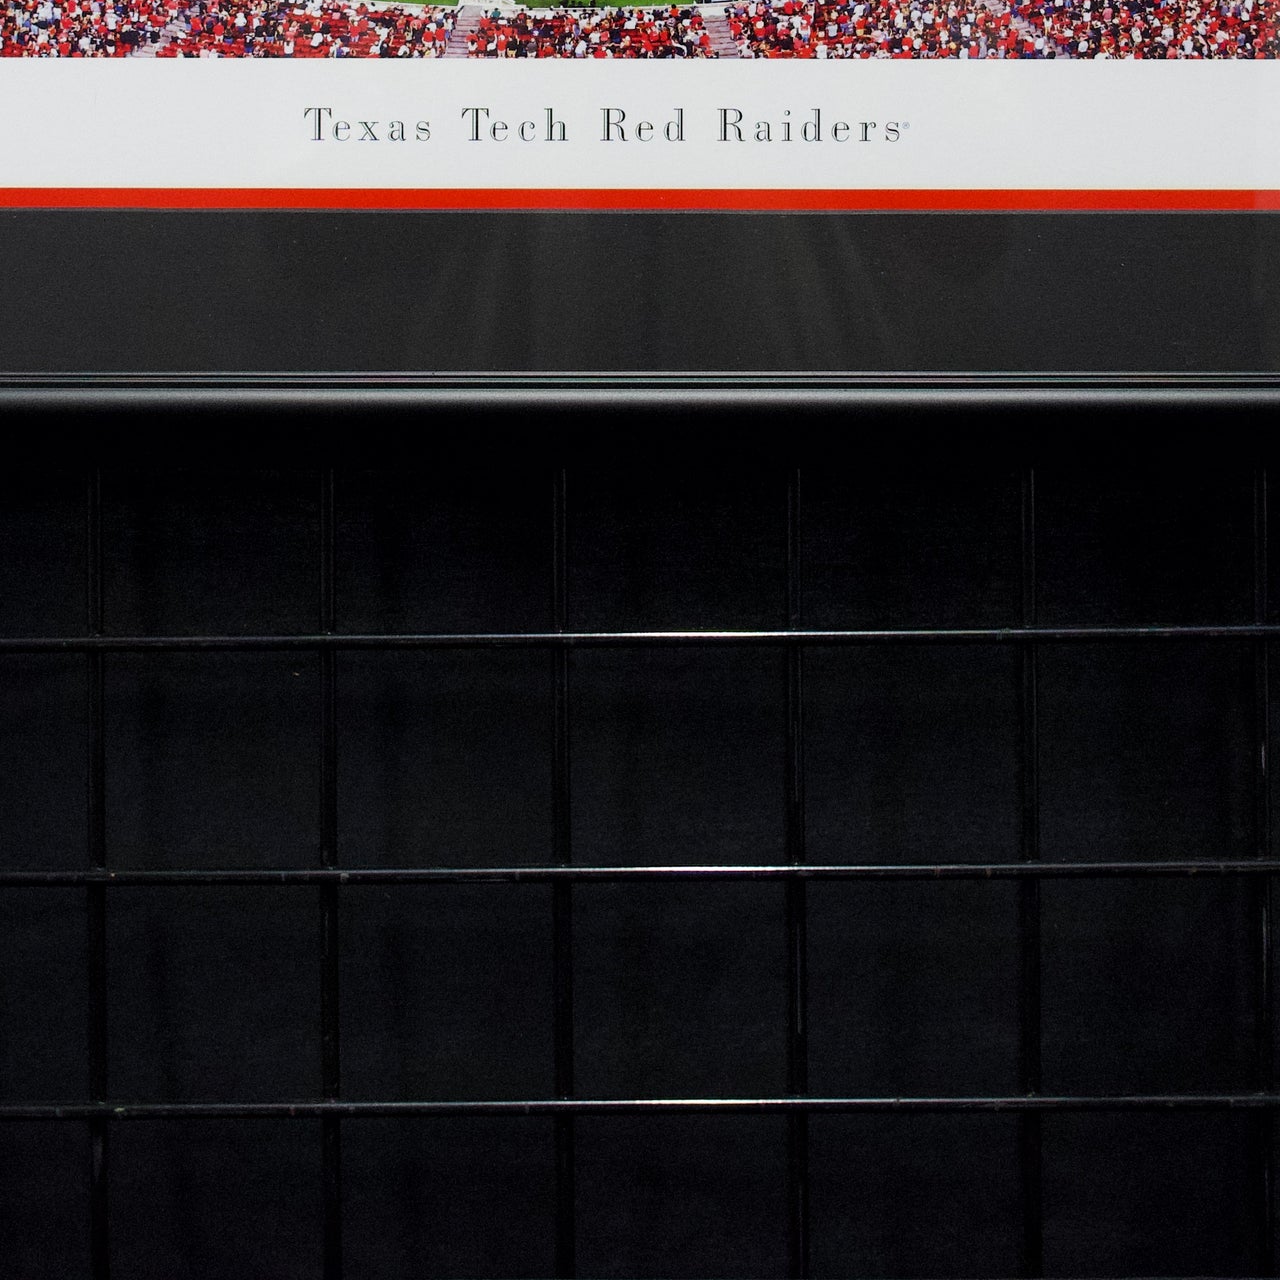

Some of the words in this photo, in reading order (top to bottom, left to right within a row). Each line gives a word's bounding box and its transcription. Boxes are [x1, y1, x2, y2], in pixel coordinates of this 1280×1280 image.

[304, 107, 432, 142] Texas
[461, 107, 569, 142] Tech
[601, 107, 687, 142] Red
